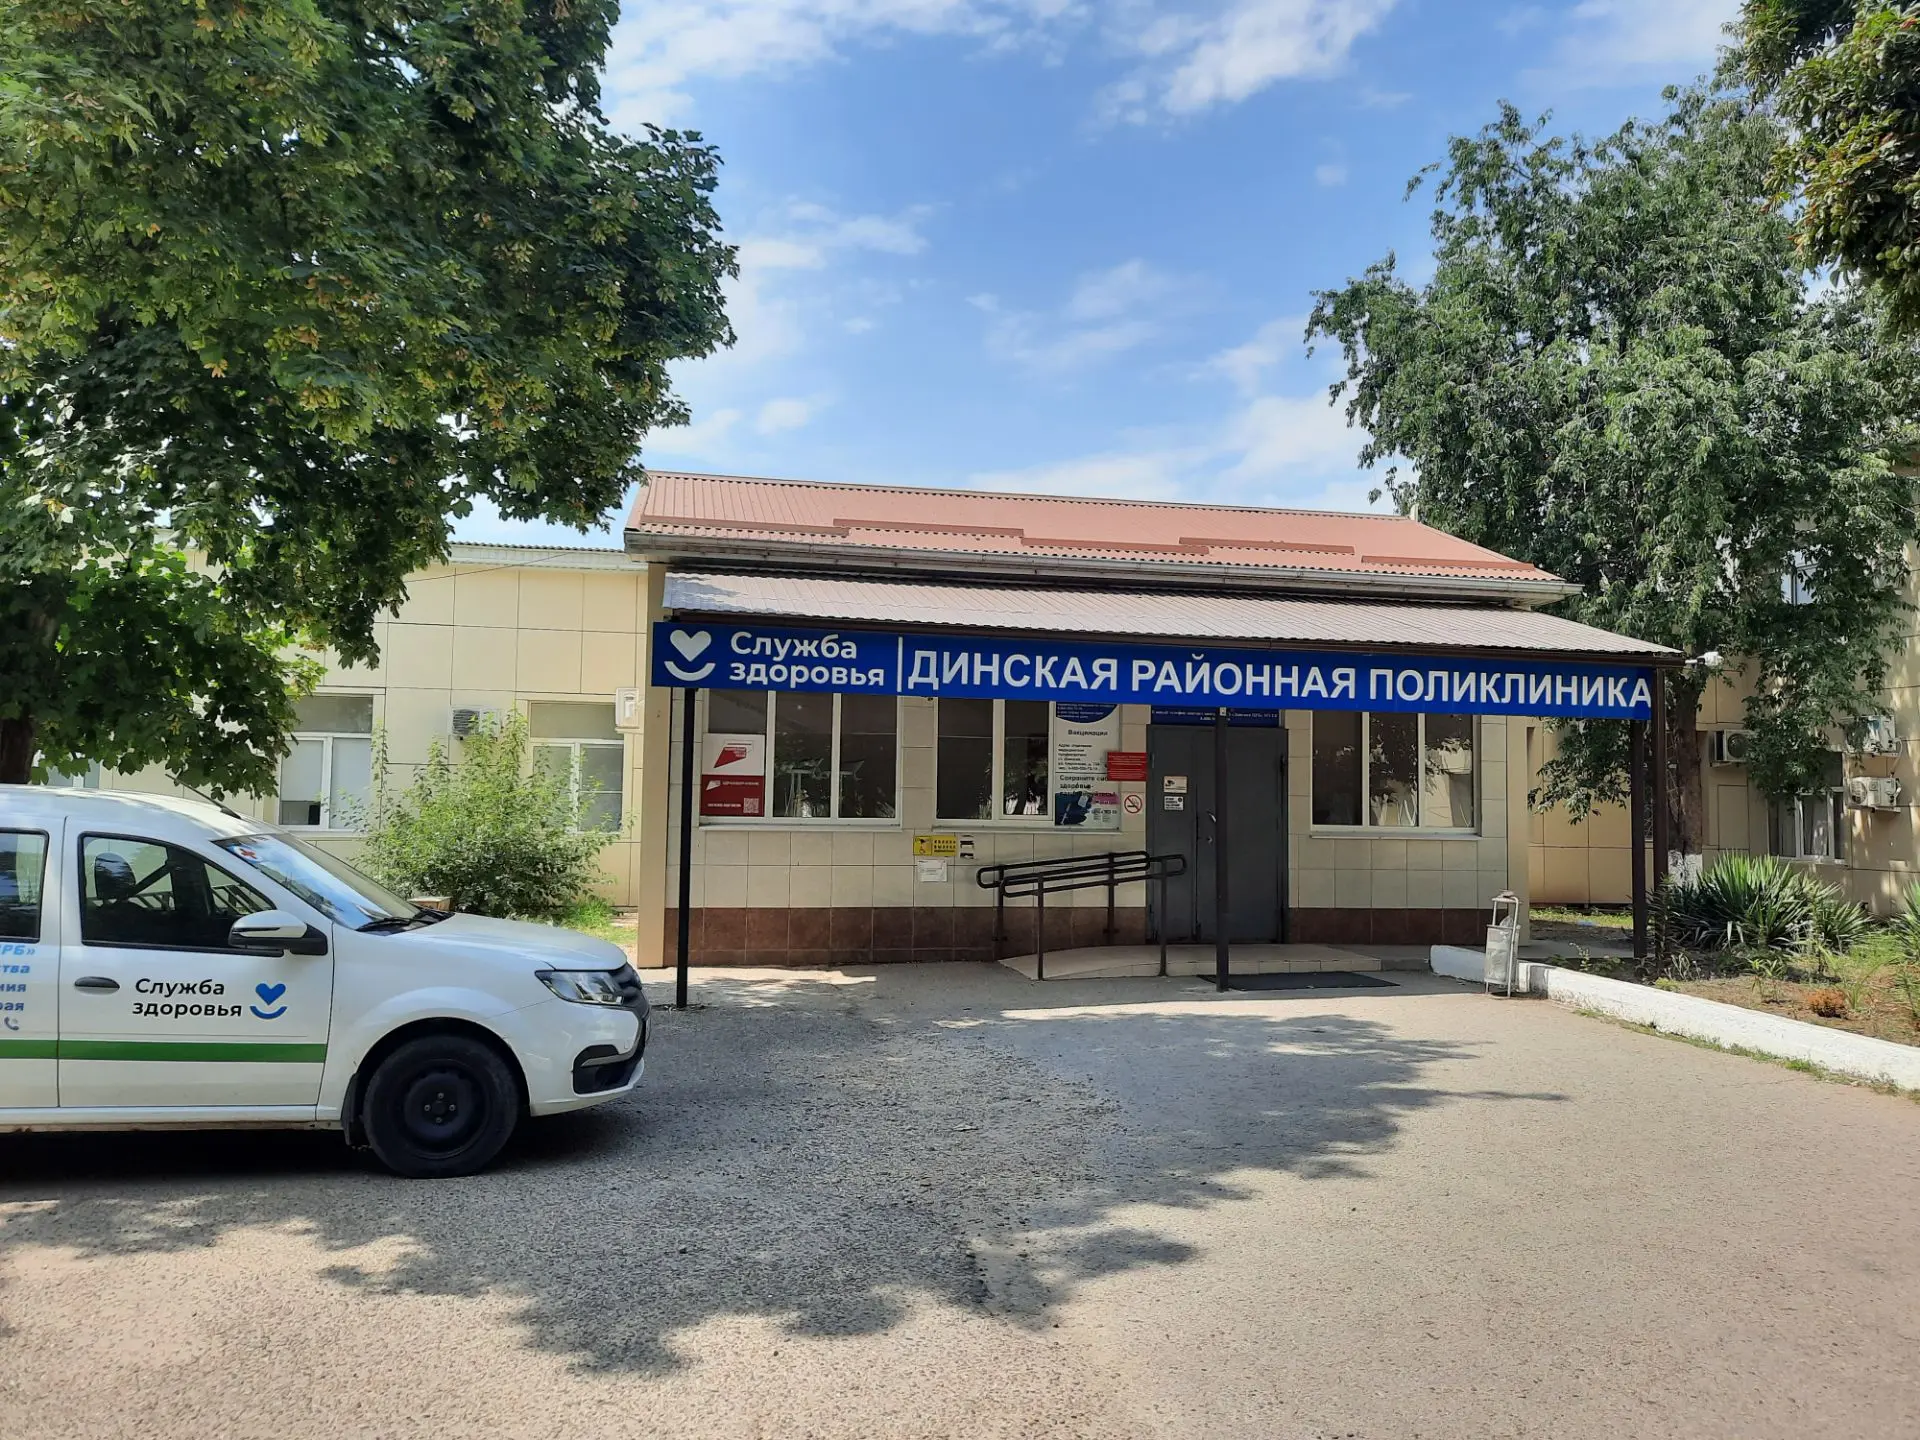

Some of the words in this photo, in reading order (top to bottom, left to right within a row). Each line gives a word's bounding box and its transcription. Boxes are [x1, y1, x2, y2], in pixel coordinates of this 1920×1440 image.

[730, 631, 857, 662] Служба
[729, 662, 885, 688] здоровья
[908, 650, 1118, 691] ДИНСКАЯ
[1131, 653, 1356, 699] РАЙОННАЯ
[1369, 667, 1652, 708] ПОЛИКЛИНИКА
[0, 944, 36, 956] РБ»
[135, 978, 225, 998] Служба
[132, 1002, 242, 1019] здоровья
